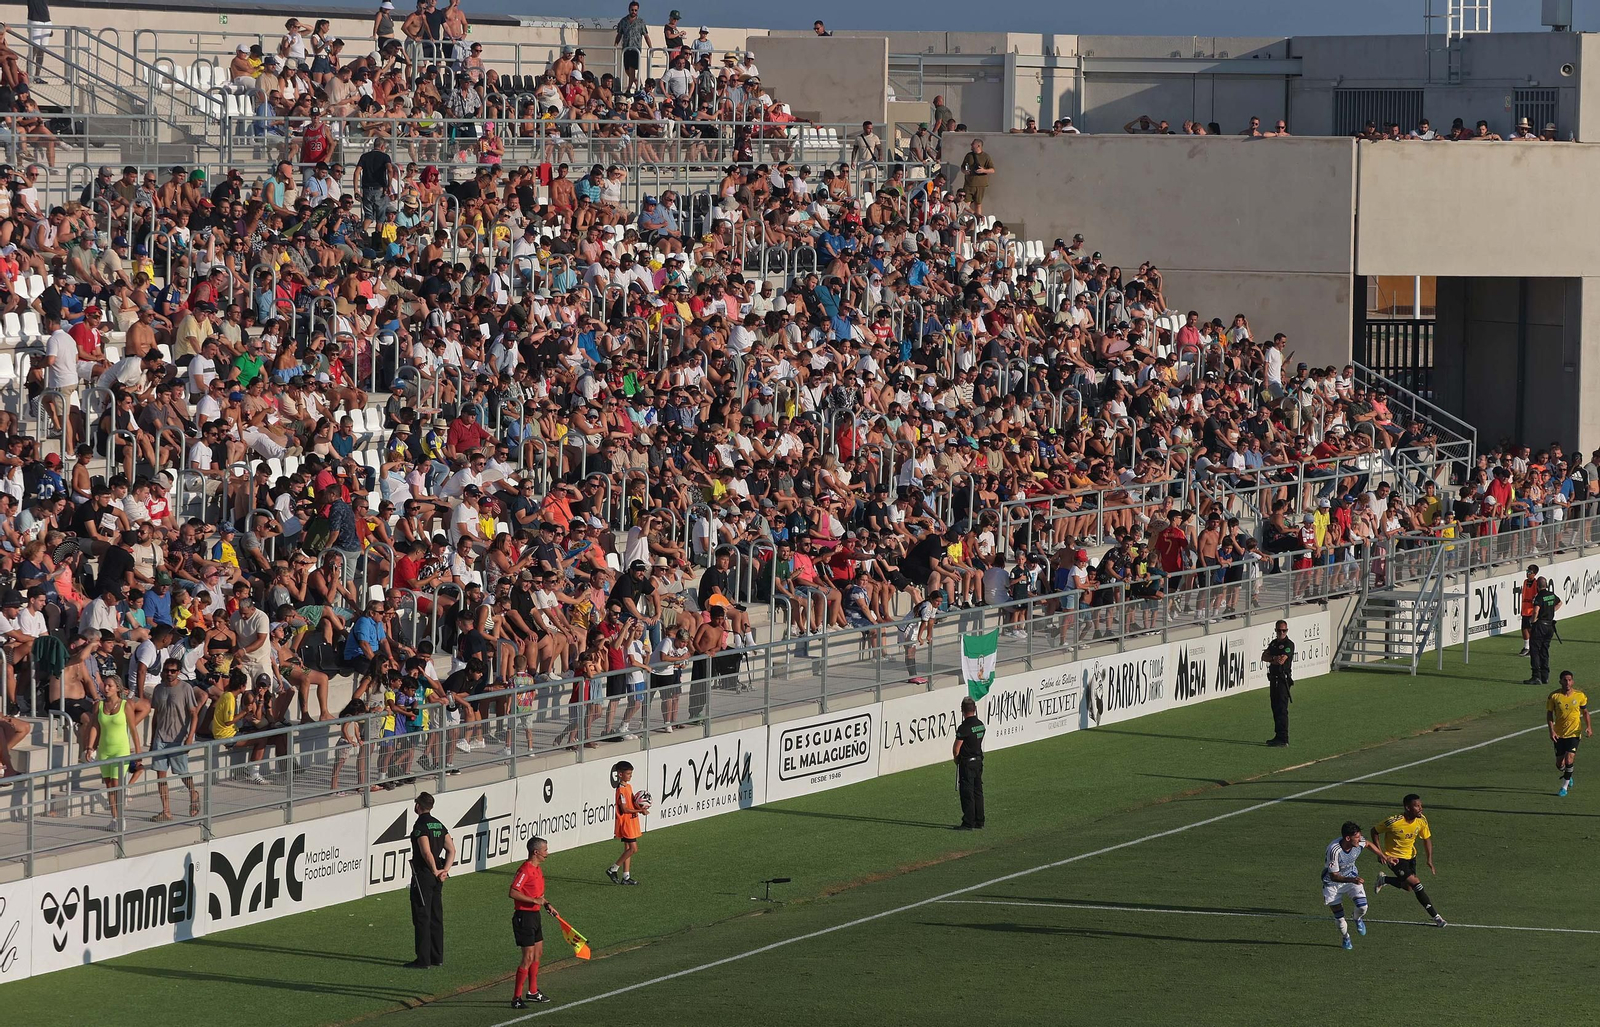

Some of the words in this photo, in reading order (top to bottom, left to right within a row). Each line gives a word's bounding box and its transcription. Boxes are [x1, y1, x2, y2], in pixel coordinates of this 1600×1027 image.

[311, 141, 322, 151] 23
[1108, 660, 1147, 711] BARBAS
[1038, 692, 1077, 717] VELVET
[784, 721, 867, 752] DESGUACES
[884, 720, 904, 752] LA
[783, 756, 796, 772] EL
[799, 740, 867, 769] MALAGUEÑO
[661, 763, 682, 805] La
[688, 739, 752, 796] Velada
[810, 775, 827, 784] DESDE
[660, 803, 688, 819] MESÓN
[696, 789, 752, 811] RESTAURANTE
[515, 813, 576, 842] feralmansa
[304, 863, 336, 881] Football
[337, 858, 362, 873] Center
[305, 846, 340, 865] Marbella
[370, 847, 411, 885] LOT
[452, 825, 510, 867] OTUS
[82, 862, 194, 944] hummel
